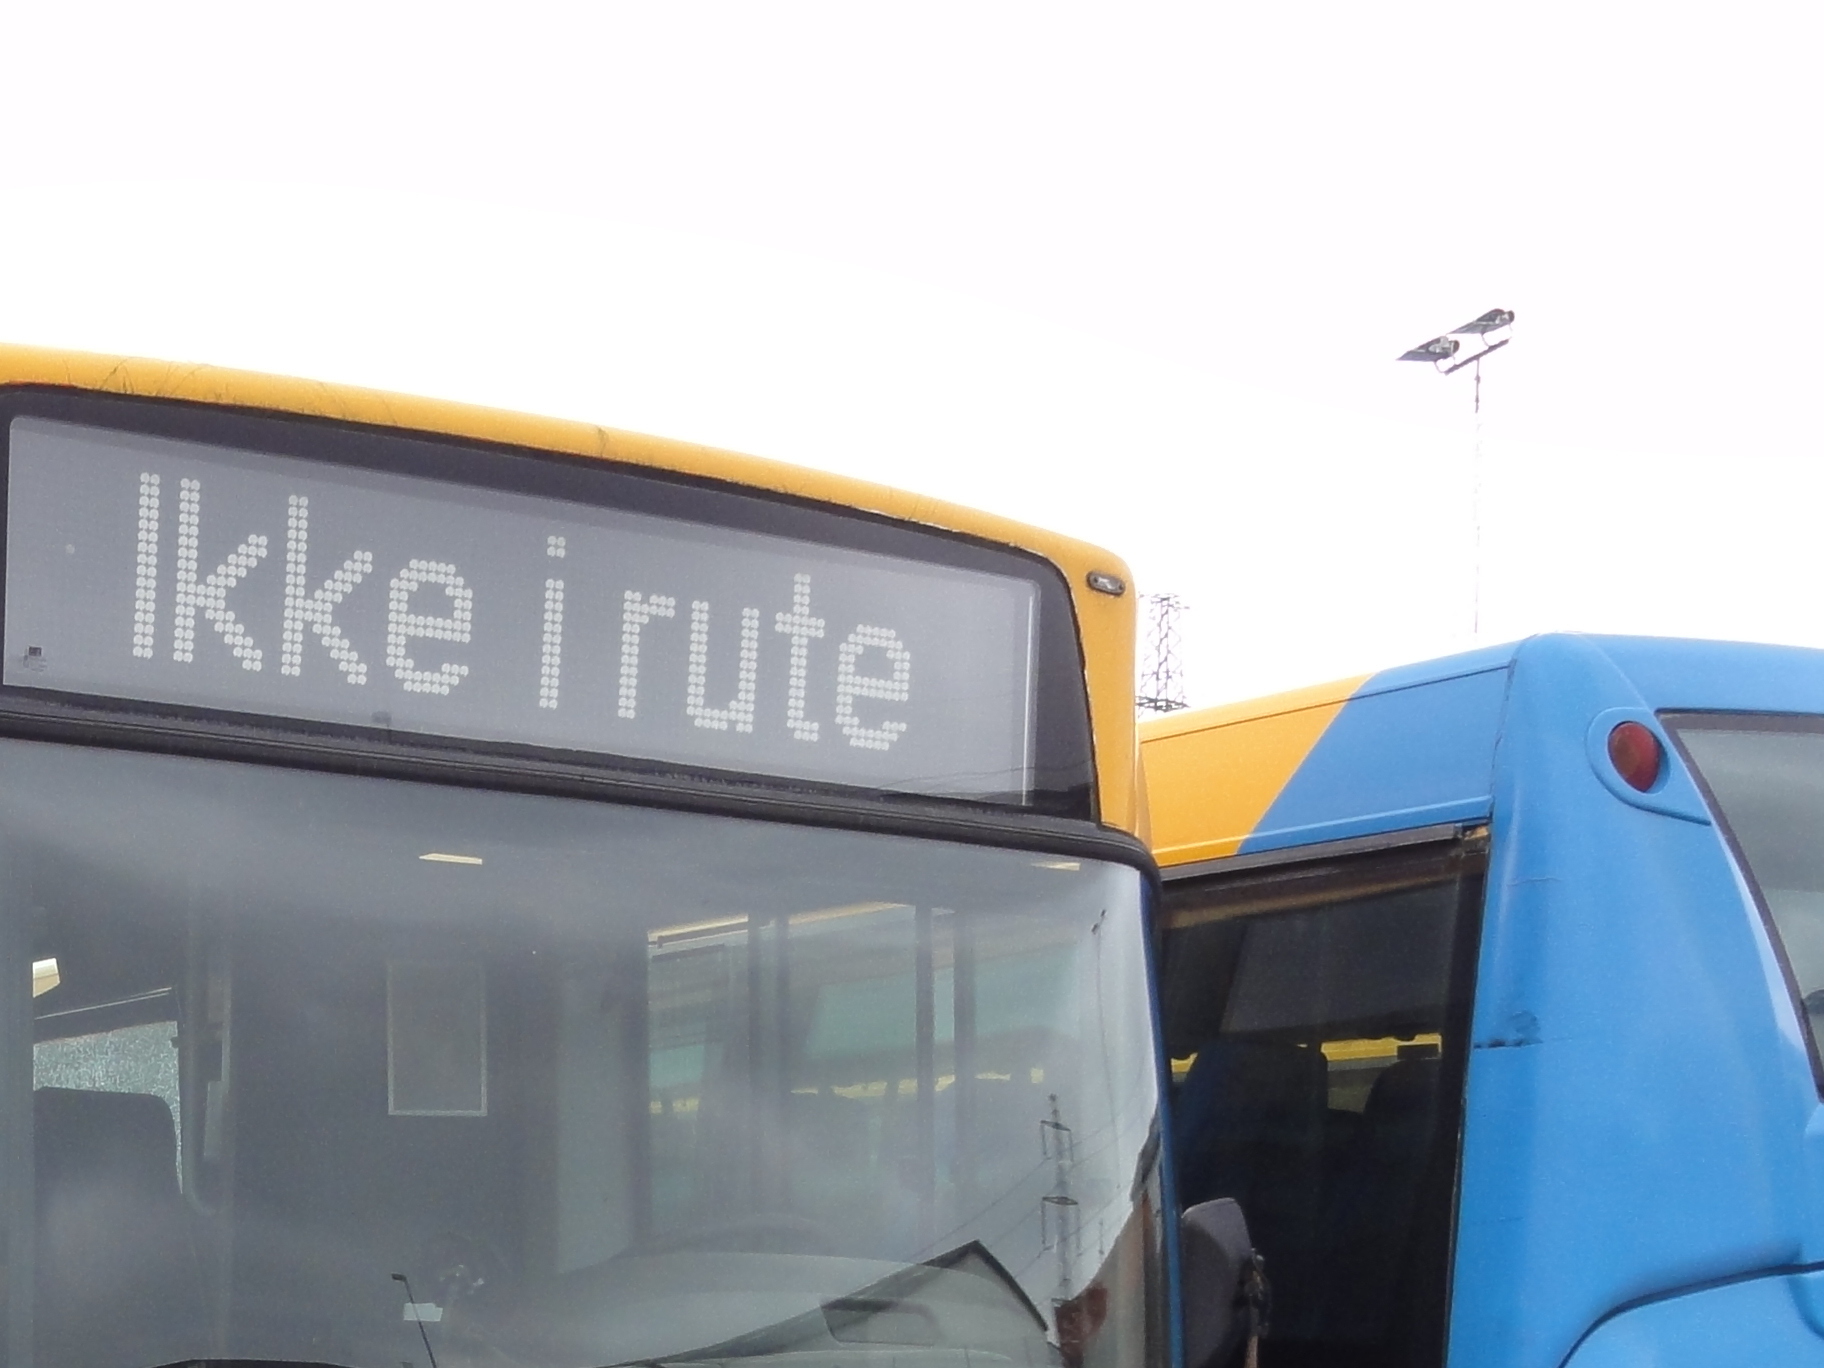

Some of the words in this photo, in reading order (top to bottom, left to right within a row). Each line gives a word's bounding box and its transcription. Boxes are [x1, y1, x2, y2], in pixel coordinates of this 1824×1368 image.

[132, 472, 473, 696] Ikke
[539, 535, 566, 709] i
[617, 573, 911, 750] rute
